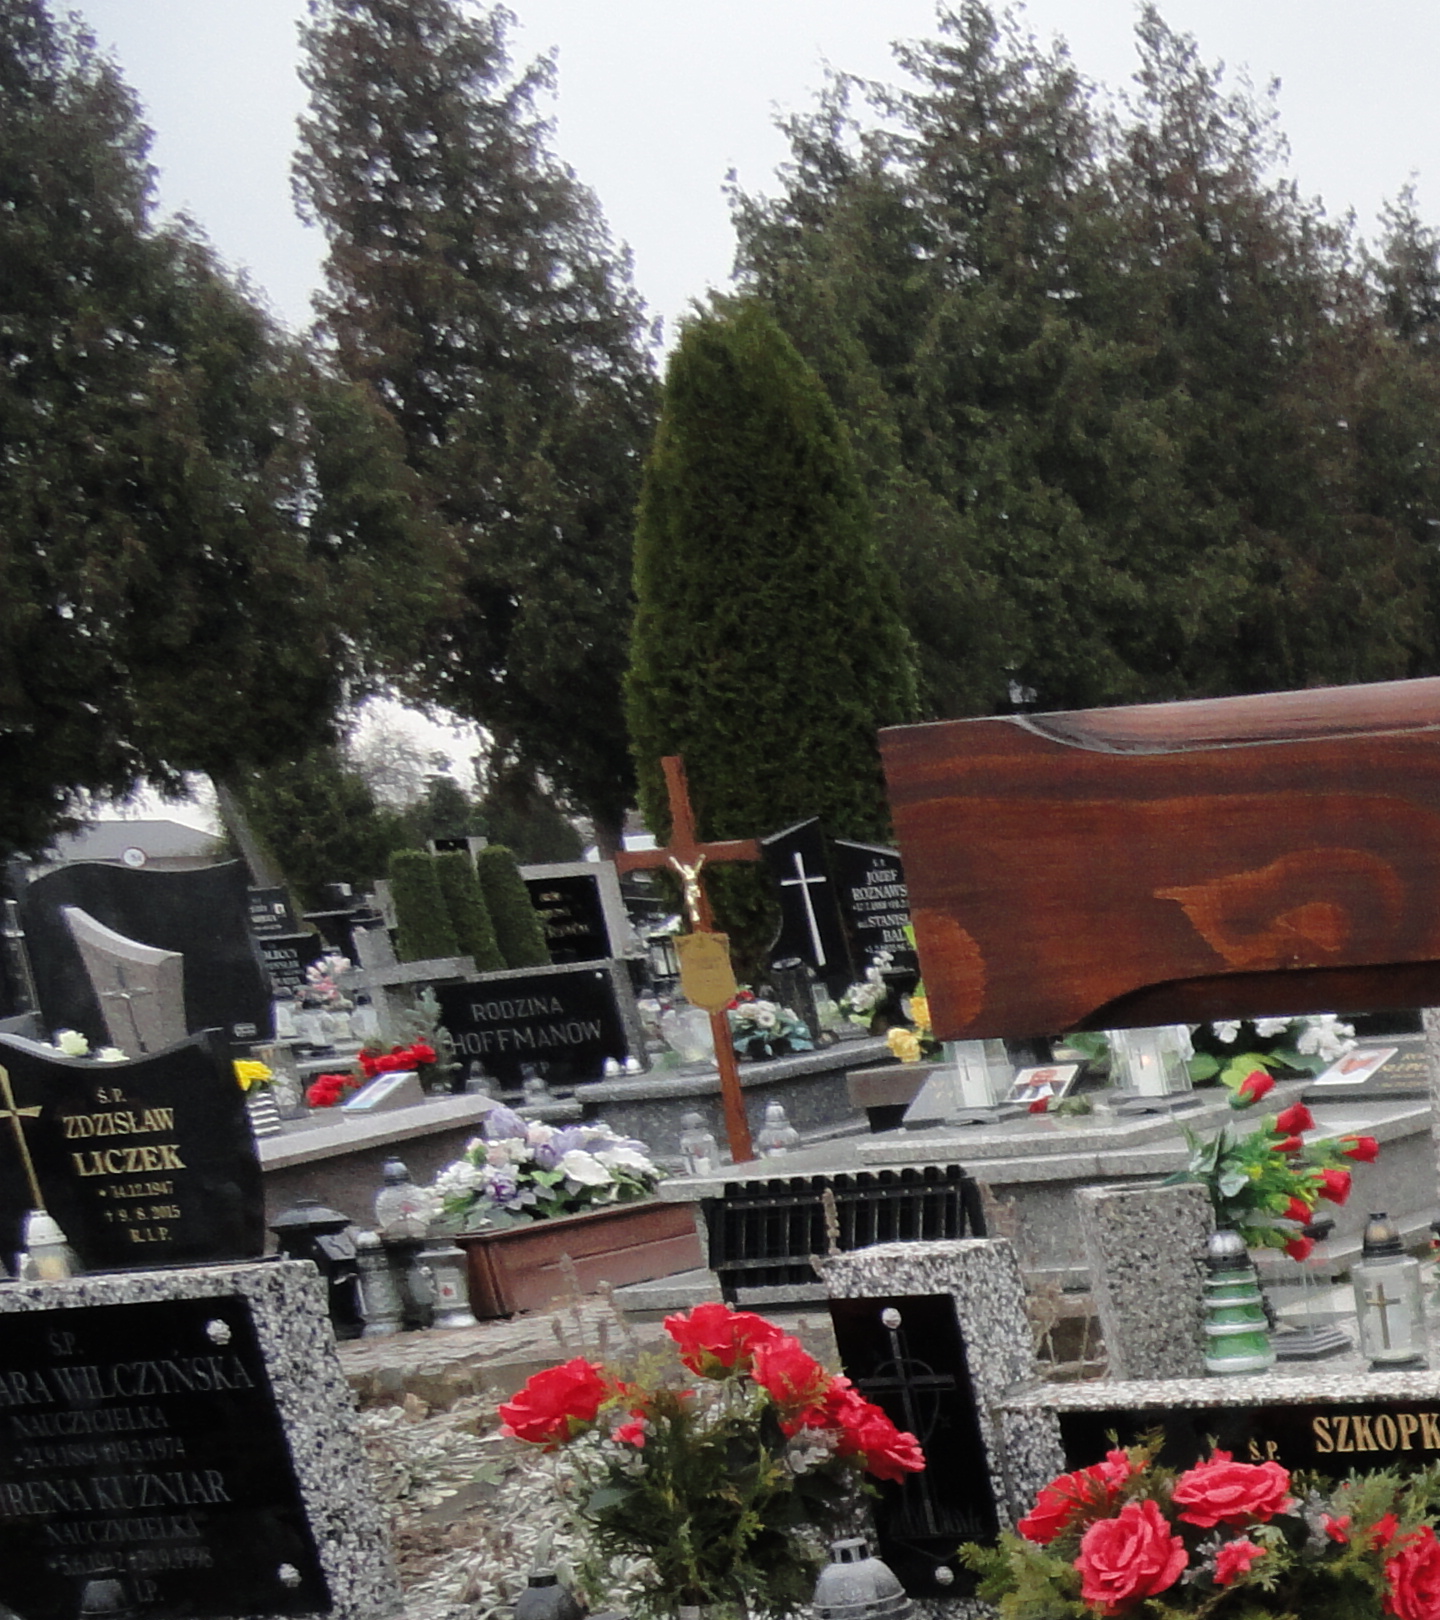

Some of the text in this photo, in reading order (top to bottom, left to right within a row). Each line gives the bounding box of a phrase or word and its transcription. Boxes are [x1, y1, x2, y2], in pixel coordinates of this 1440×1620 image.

[470, 996, 564, 1022] RODZINA
[62, 1106, 175, 1139] ZDZISŁAW
[71, 1144, 188, 1177] LICZEK
[50, 1350, 256, 1401] WILCZYŃSKA
[9, 1405, 170, 1438] NAUCZYCIELKA
[0, 1478, 92, 1516] IRENA
[44, 1516, 201, 1546] NAUCZYCIELKA
